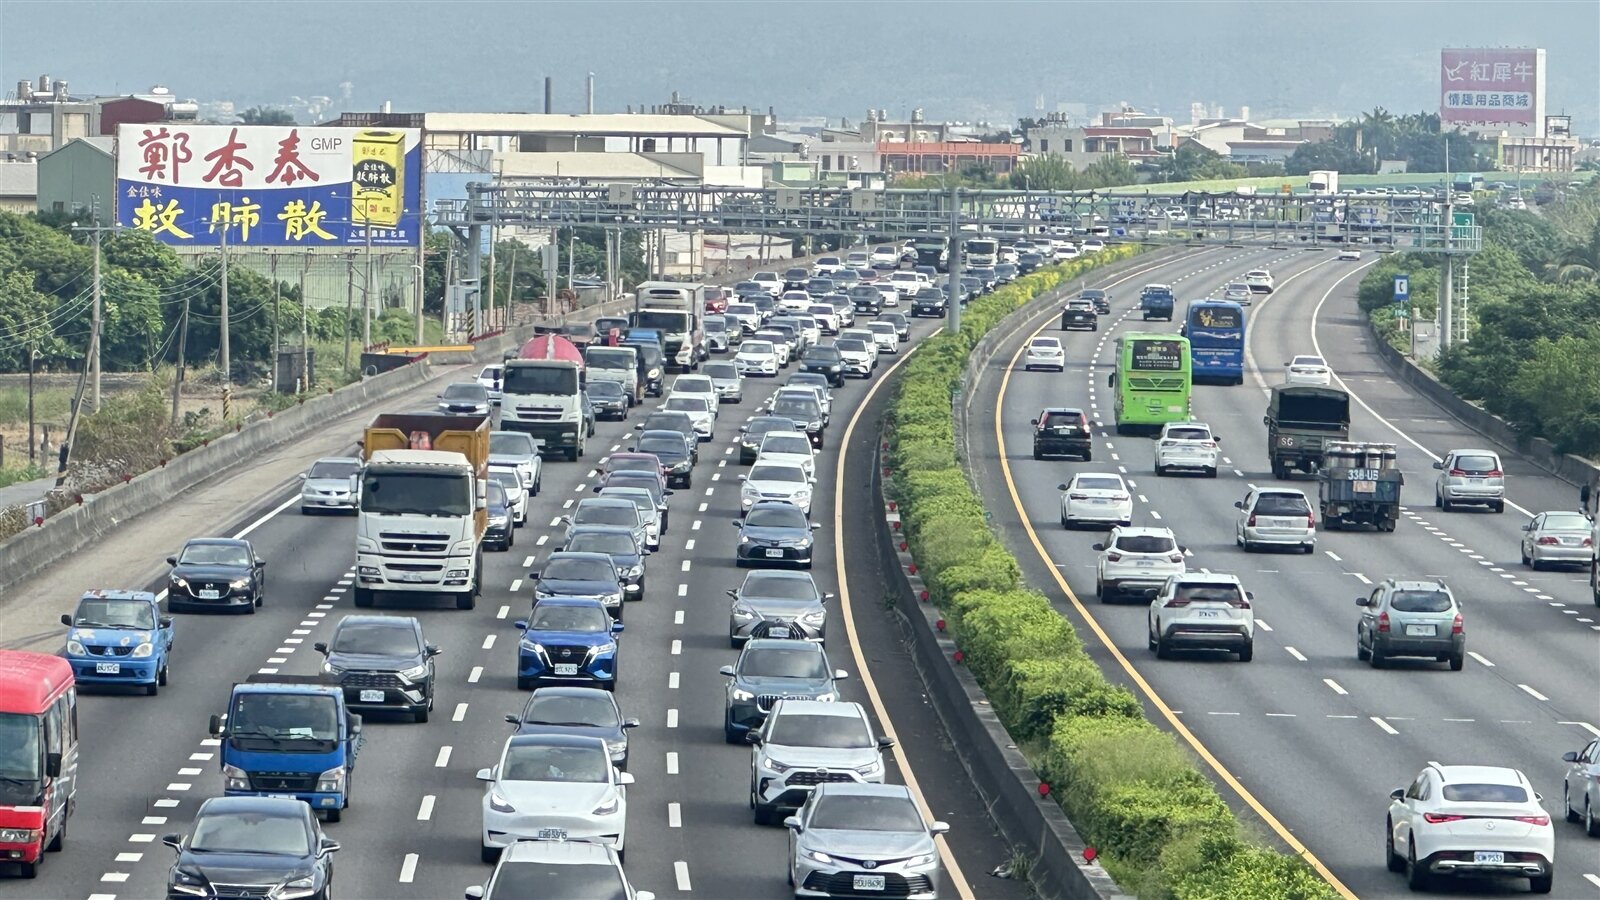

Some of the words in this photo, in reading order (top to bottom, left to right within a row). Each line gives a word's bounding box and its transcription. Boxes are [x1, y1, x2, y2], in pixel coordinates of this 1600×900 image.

[1470, 61, 1534, 82] 紅犀牛
[1448, 92, 1529, 107] 情趣用品商城
[310, 137, 343, 151] GMP
[137, 126, 320, 188] 鄭杏泰
[126, 185, 163, 199] 金佳味
[132, 197, 339, 242] 救肺散
[1281, 437, 1294, 447] SG
